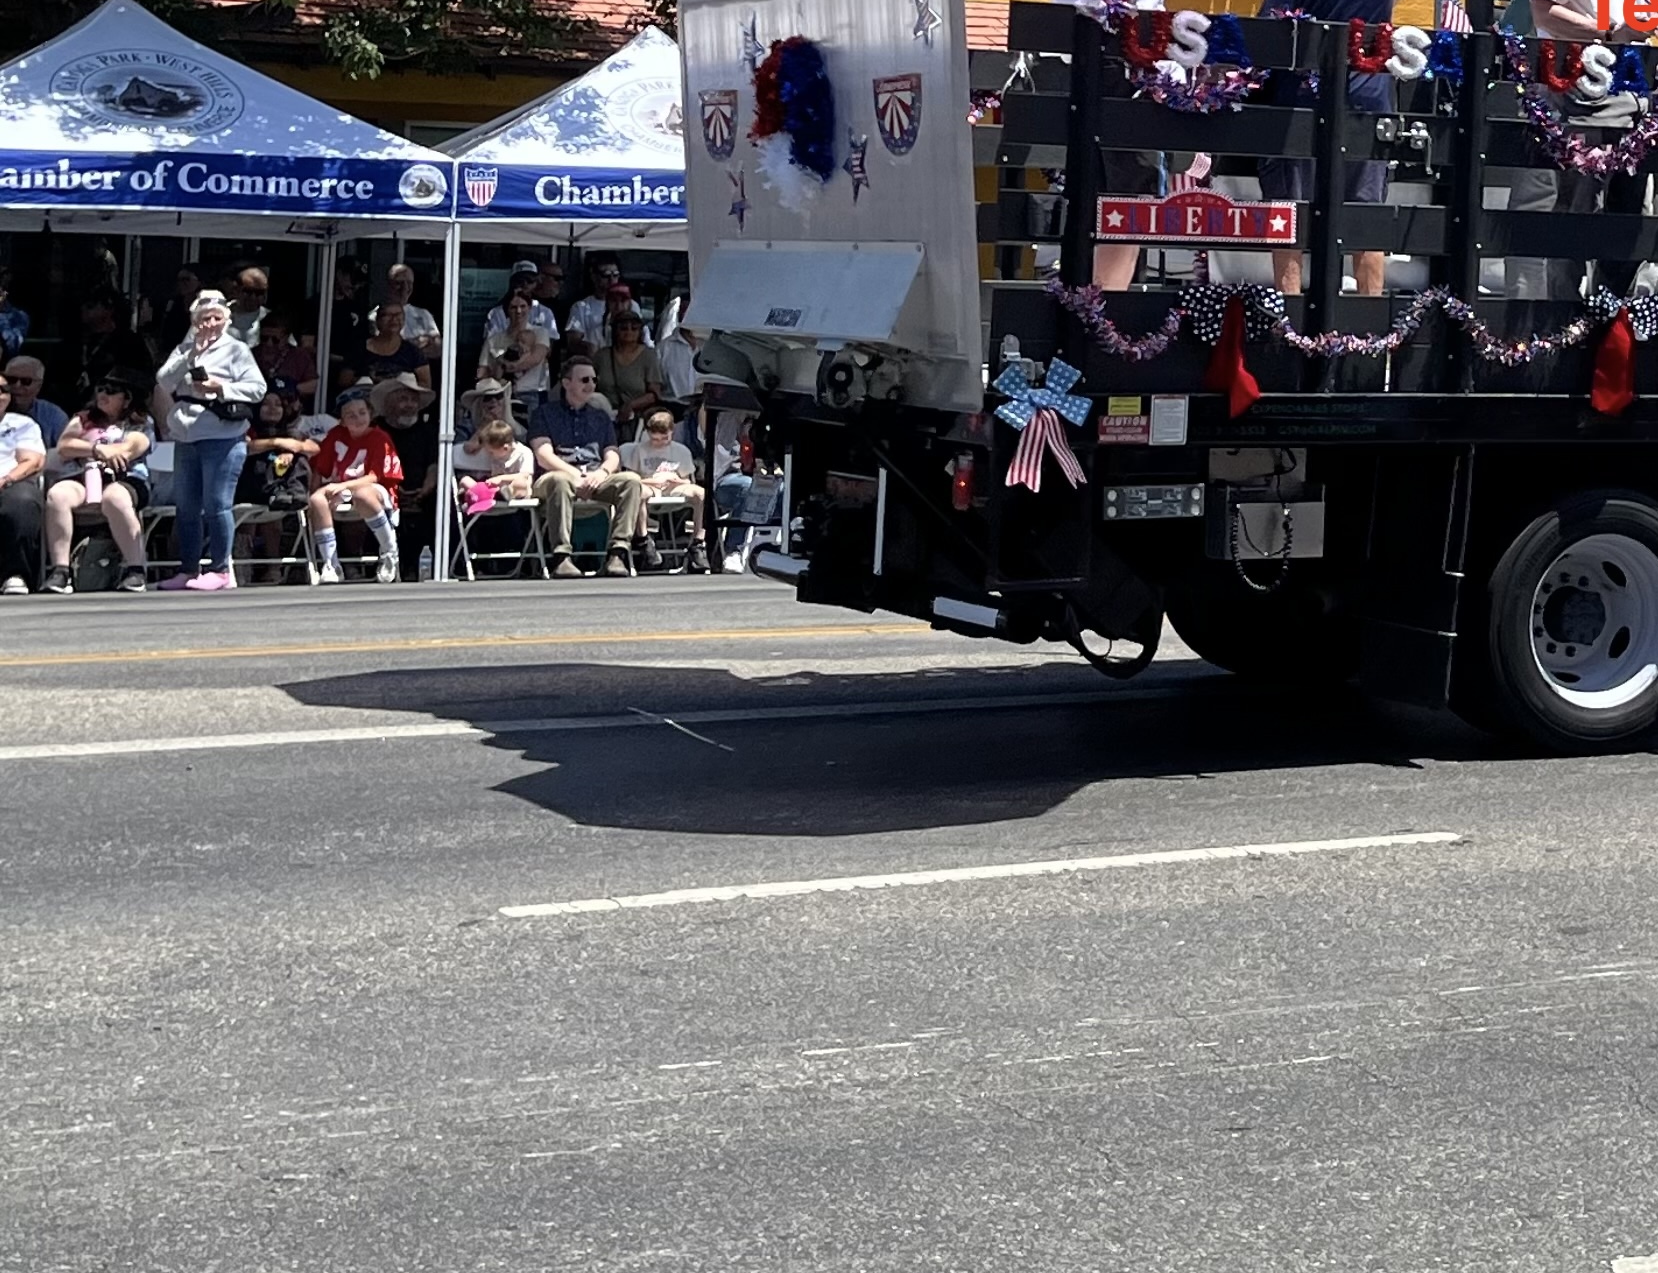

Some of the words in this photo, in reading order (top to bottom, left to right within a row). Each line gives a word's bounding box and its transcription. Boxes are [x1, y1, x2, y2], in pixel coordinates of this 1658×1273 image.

[1121, 9, 1252, 70] USA
[1349, 17, 1464, 82] USA
[97, 52, 142, 69] PARK
[154, 52, 202, 74] WEST
[199, 70, 236, 100] HILLS
[640, 79, 674, 94] PARK
[1538, 39, 1650, 100] USA
[129, 160, 174, 192] of
[177, 162, 375, 200] Commerce
[534, 175, 685, 206] Chamber
[1127, 204, 1269, 236] LIBERTY
